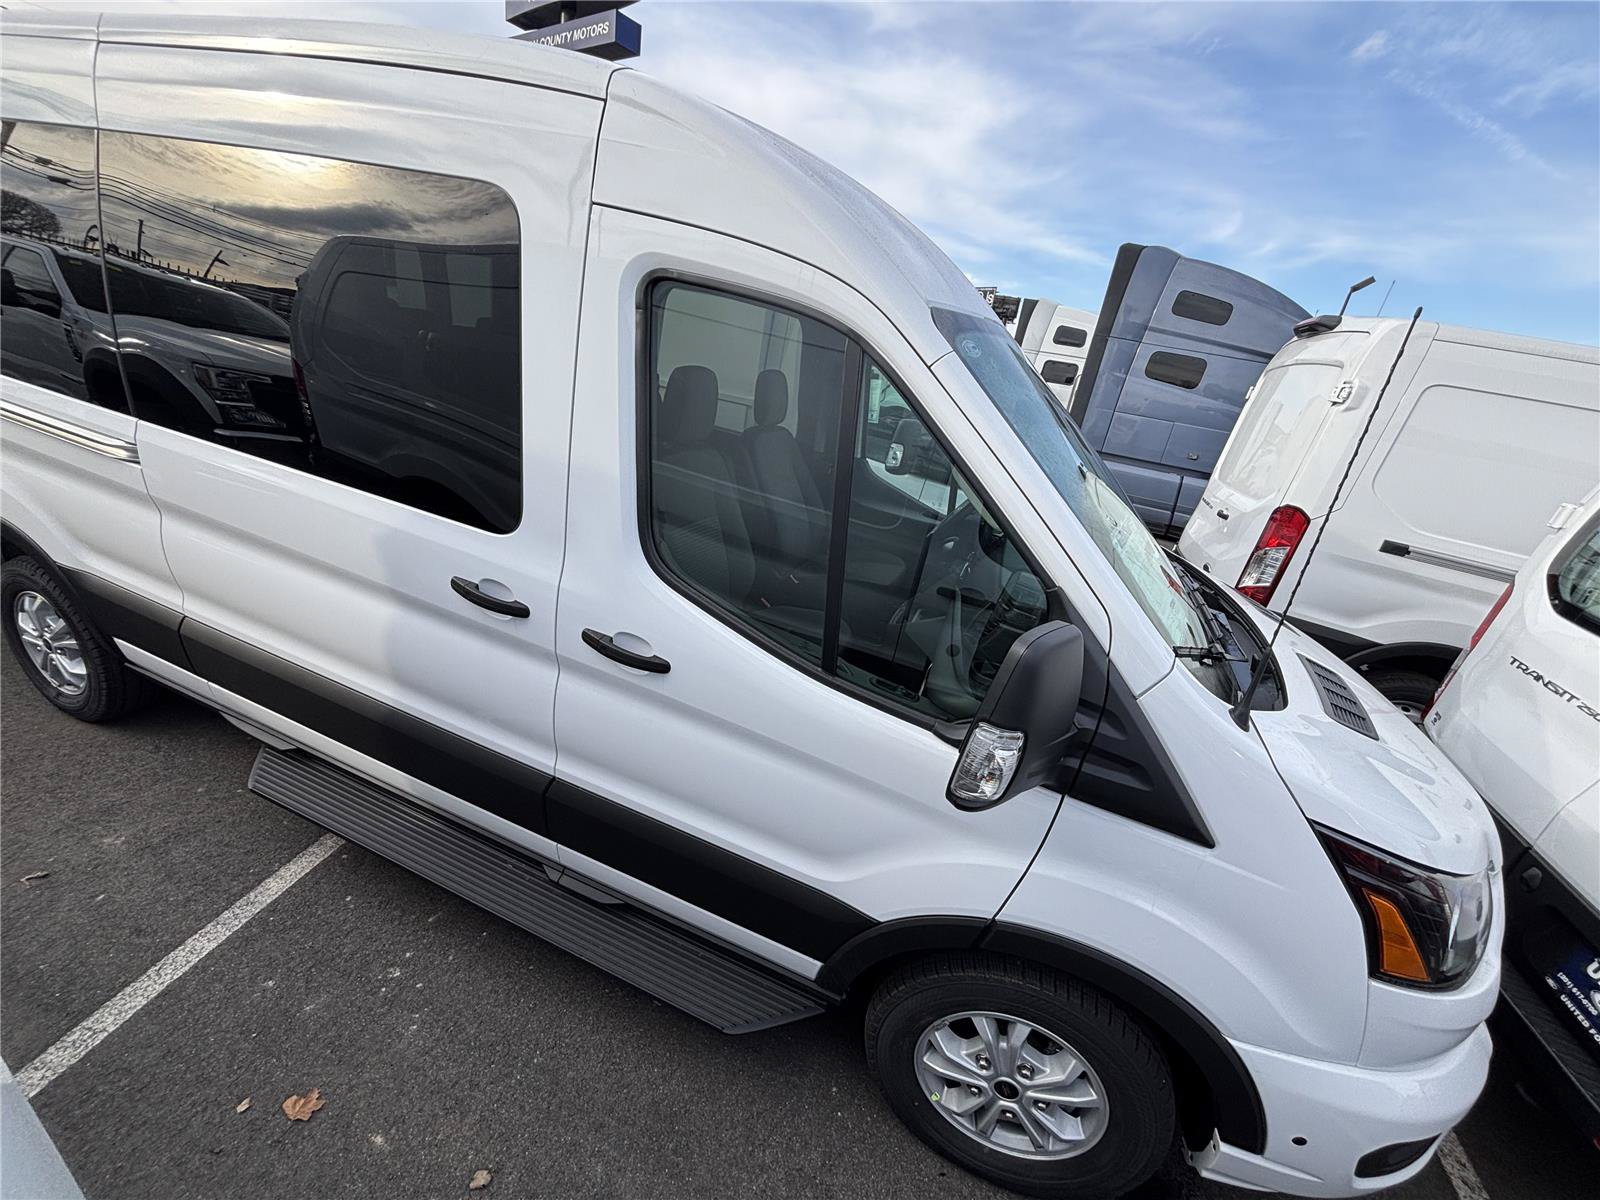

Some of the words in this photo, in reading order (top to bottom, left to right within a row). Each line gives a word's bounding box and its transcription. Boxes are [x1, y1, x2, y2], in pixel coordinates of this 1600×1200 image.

[539, 31, 573, 46] COUNTY
[572, 21, 610, 41] MOTORS
[1509, 655, 1580, 703] TRANSIT
[1560, 994, 1590, 1028] UNITED
[1588, 1028, 1600, 1045] FO
